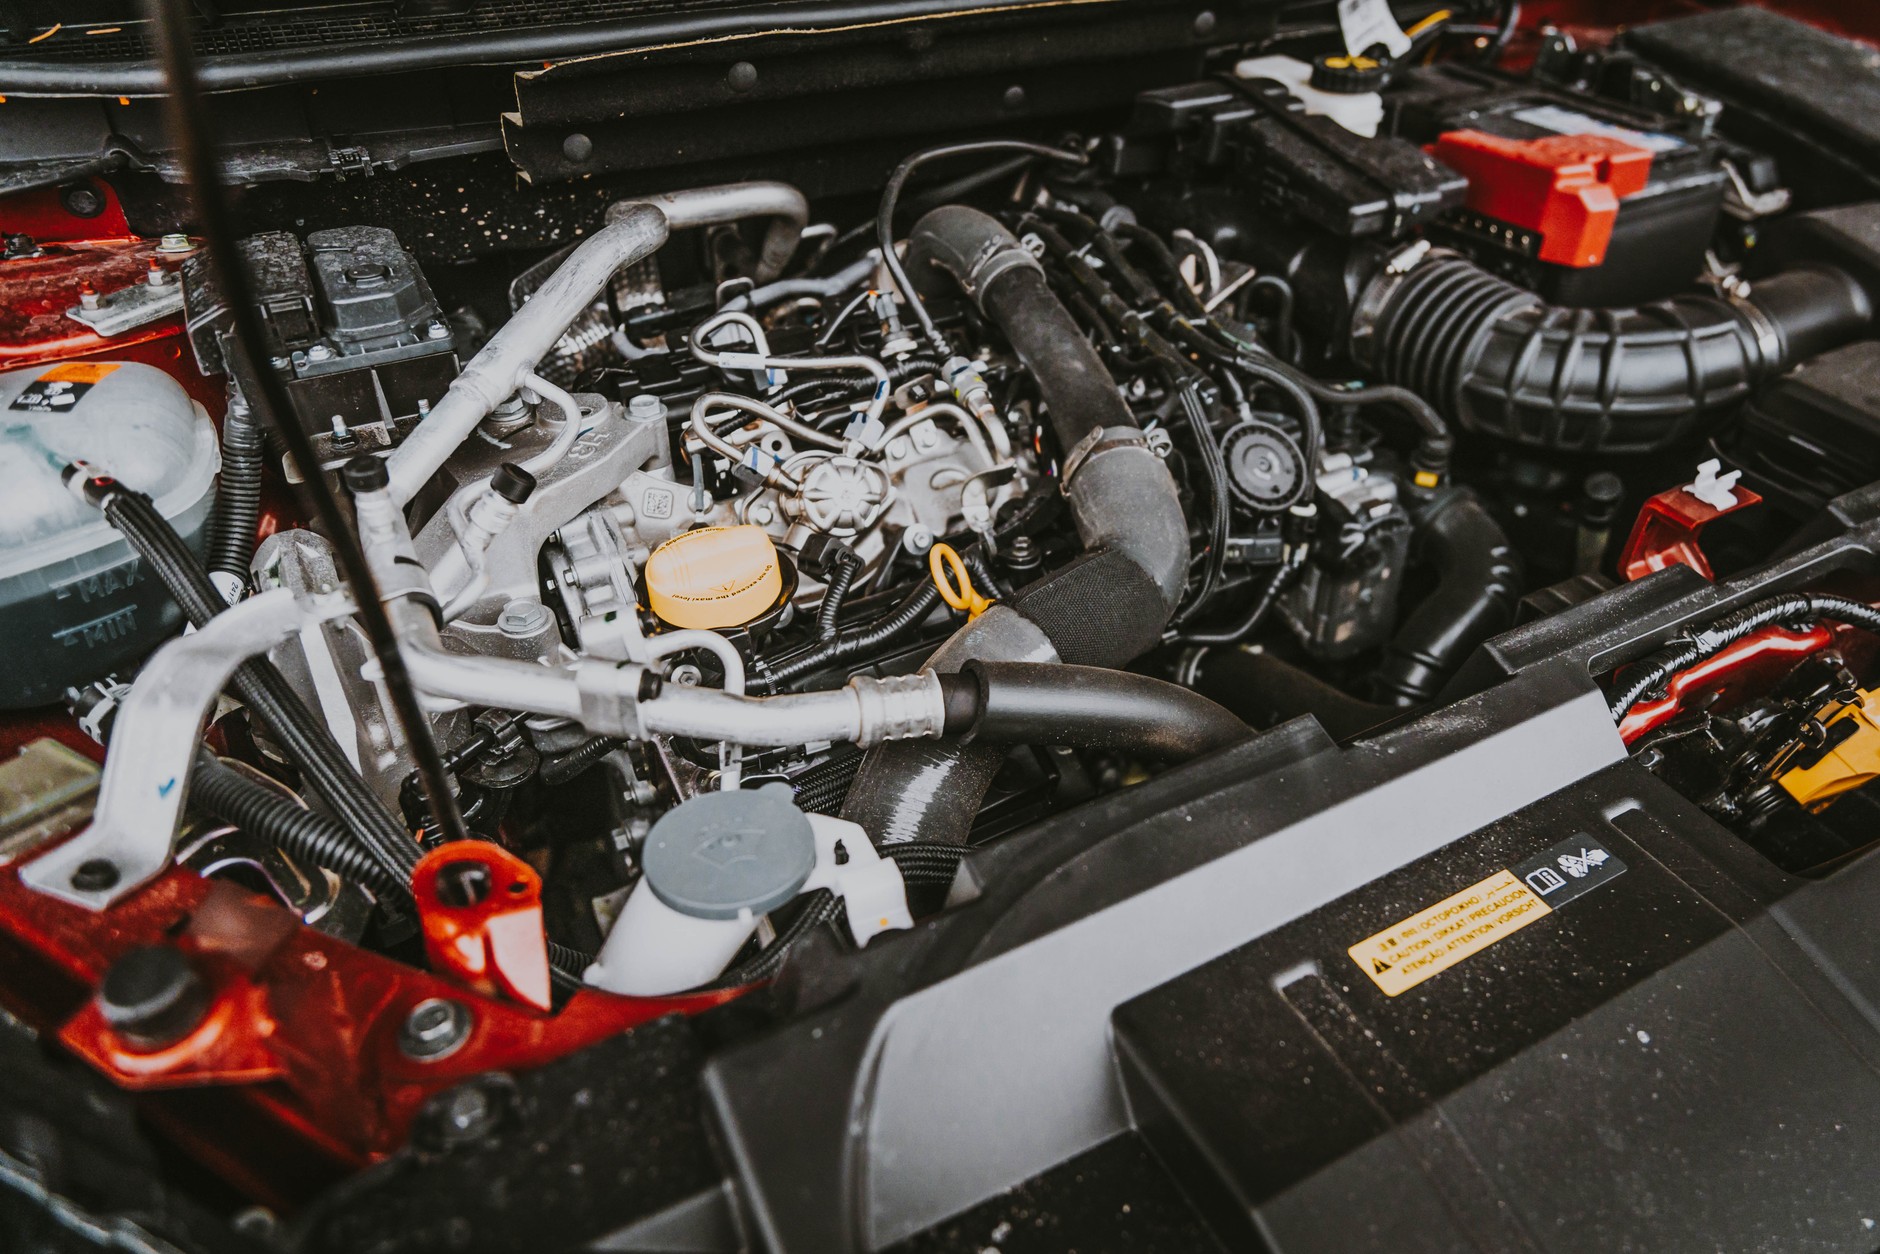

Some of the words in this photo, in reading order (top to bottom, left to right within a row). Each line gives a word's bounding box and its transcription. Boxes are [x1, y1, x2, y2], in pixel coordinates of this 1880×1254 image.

[77, 559, 144, 603] MAX
[731, 581, 757, 597] exceed
[757, 572, 767, 581] not
[672, 594, 690, 602] level
[82, 611, 137, 648] MIN
[1446, 923, 1495, 952] ATTENTION
[1496, 898, 1539, 925] VORSICHT
[1388, 938, 1432, 963] CAUTION
